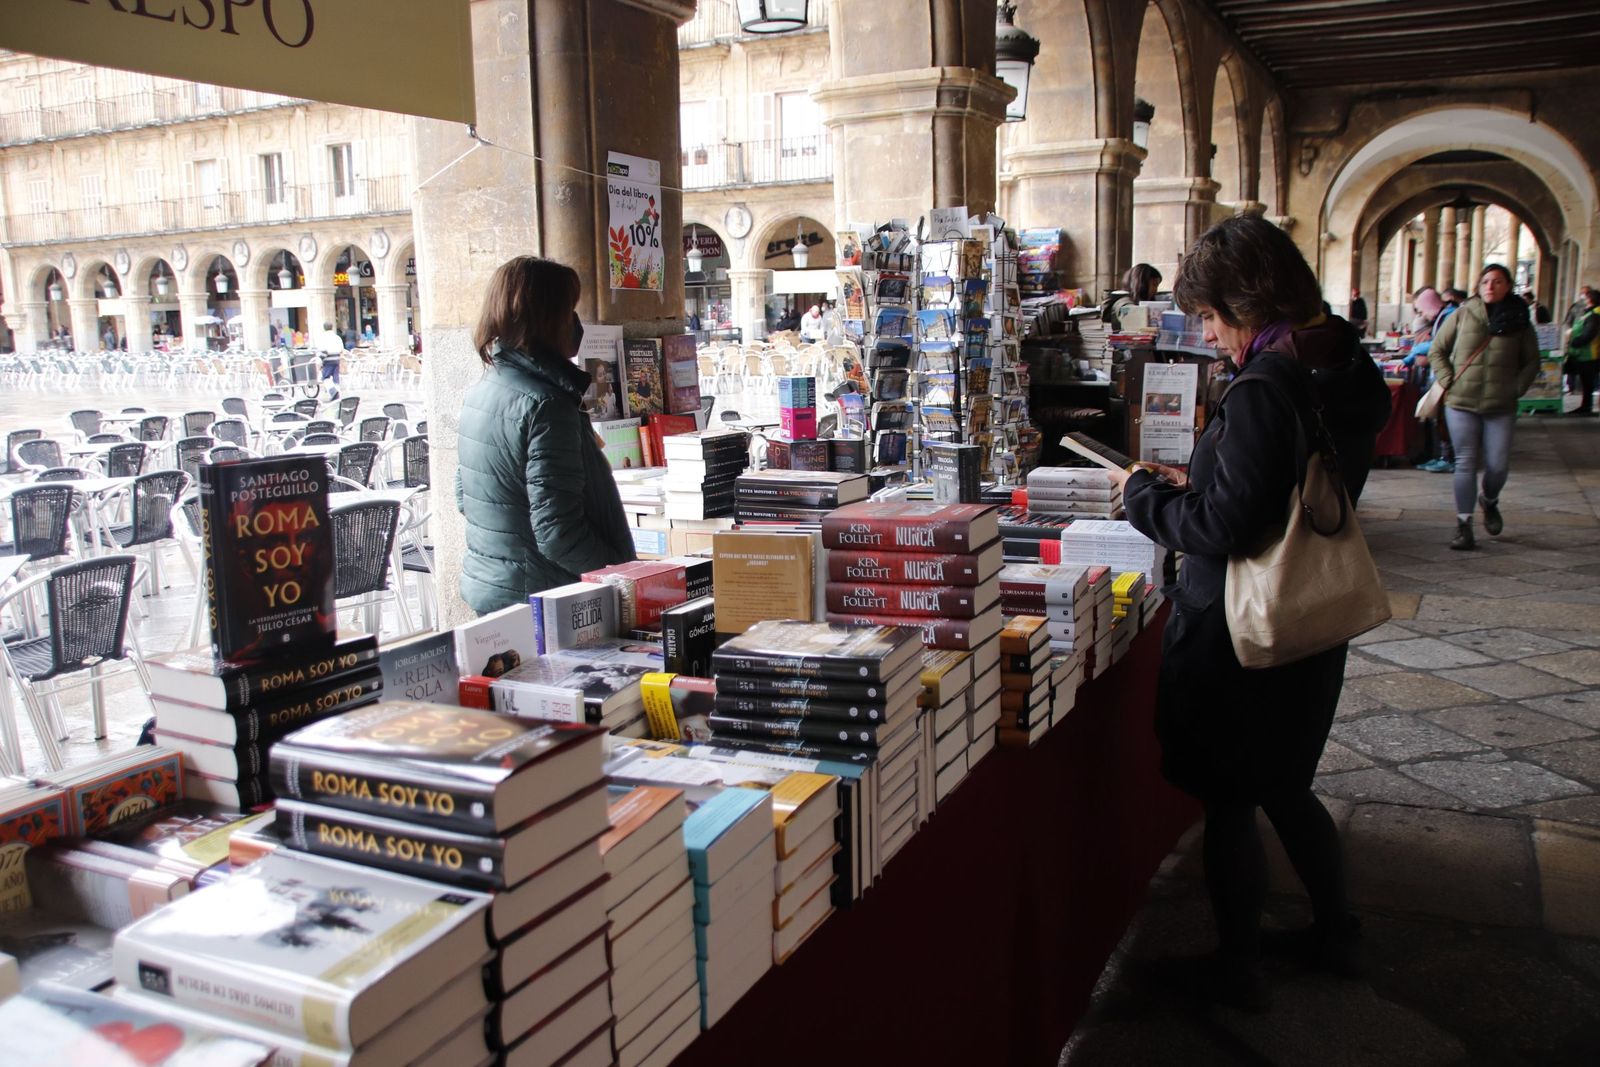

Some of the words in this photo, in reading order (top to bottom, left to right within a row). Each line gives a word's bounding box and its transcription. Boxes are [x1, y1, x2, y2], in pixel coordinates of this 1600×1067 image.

[608, 184, 621, 196] Día
[621, 185, 633, 197] del
[633, 187, 649, 200] libro
[629, 223, 659, 248] 10%
[239, 469, 310, 489] SANTIAGO
[231, 481, 319, 502] POSTEGUILLO
[236, 505, 320, 539] ROMA
[850, 523, 871, 533] KEN
[200, 508, 212, 560] ROMA
[839, 532, 883, 544] FOLLETT
[895, 526, 935, 547] NUNCA
[255, 542, 307, 573] SOY
[858, 557, 879, 567] KEN
[846, 566, 891, 579] FOLLETT
[904, 560, 944, 581] NUNCA
[206, 567, 216, 601] SOY
[263, 580, 301, 608] YO
[854, 587, 875, 597] KEN
[843, 596, 888, 608] FOLLETT
[900, 590, 940, 611] NUNCA
[208, 606, 218, 630] YO
[257, 620, 283, 633] JULIO
[572, 607, 603, 630] GELLIDA
[853, 617, 874, 625] KEN
[667, 628, 677, 659] CICATRIZ
[395, 653, 419, 670] JORGE
[420, 645, 447, 660] MOLIST
[262, 668, 305, 693] ROMA
[309, 658, 335, 679] SOY
[339, 652, 358, 669] YO
[405, 660, 451, 686] REINA
[405, 679, 444, 701] SOLA
[270, 703, 312, 726] ROMA
[317, 690, 342, 711] SOY
[345, 685, 362, 702] YO
[409, 719, 478, 746] SOY
[457, 728, 513, 747] YO
[312, 770, 373, 800] ROMA
[378, 783, 417, 808] SOY
[425, 791, 455, 817] YO
[319, 823, 380, 854] ROMA
[385, 835, 425, 862] SOY
[432, 846, 463, 871] YO
